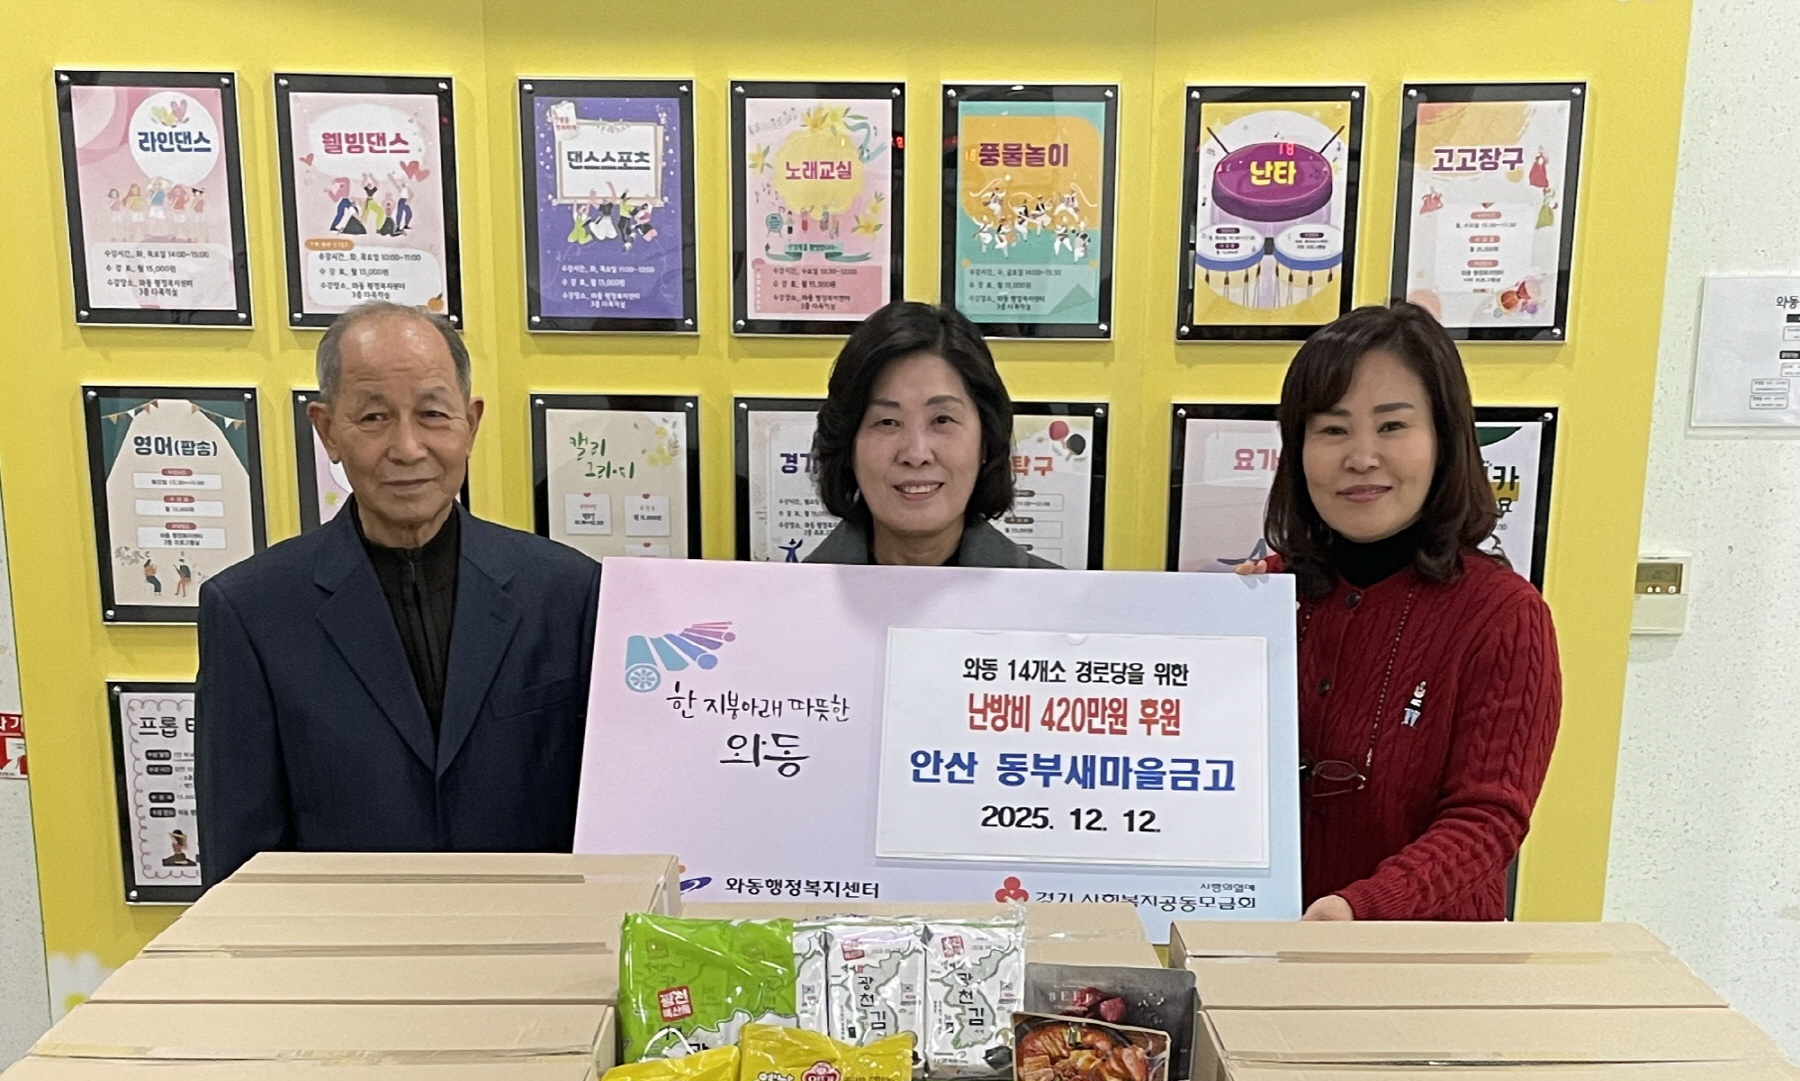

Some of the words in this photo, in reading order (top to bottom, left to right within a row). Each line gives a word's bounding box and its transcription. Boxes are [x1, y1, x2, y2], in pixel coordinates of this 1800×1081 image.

[137, 131, 212, 153] 라인댄스
[321, 132, 410, 155] 웰빙댄스
[567, 150, 651, 171] 댄스스포츠
[979, 142, 1069, 168] 풍물놀이
[1432, 147, 1524, 172] 고고장구
[785, 161, 853, 180] 노래교실
[1250, 160, 1297, 185] 난타
[1775, 296, 1800, 310] 와동
[133, 435, 218, 457] 영어(팝송)
[1011, 455, 1054, 477] 탁구
[962, 658, 998, 682] 와동
[1007, 659, 1066, 684] 14개소
[1075, 661, 1145, 686] 경로당을
[1153, 662, 1190, 687] 위한
[666, 681, 698, 719] 한
[703, 691, 783, 721] 지붕아래
[788, 694, 851, 722] 따뜻한
[968, 693, 1031, 733] 난방비
[1040, 696, 1129, 736] 420만원
[1138, 698, 1181, 736] 후원
[719, 733, 811, 778] 와동
[910, 750, 978, 785] 안산
[996, 752, 1237, 792] 동부새마을금고
[980, 805, 1055, 830] 2025.
[1069, 807, 1108, 832] 12.
[1123, 809, 1162, 833] 12.
[726, 877, 880, 899] 와동행정복지센터
